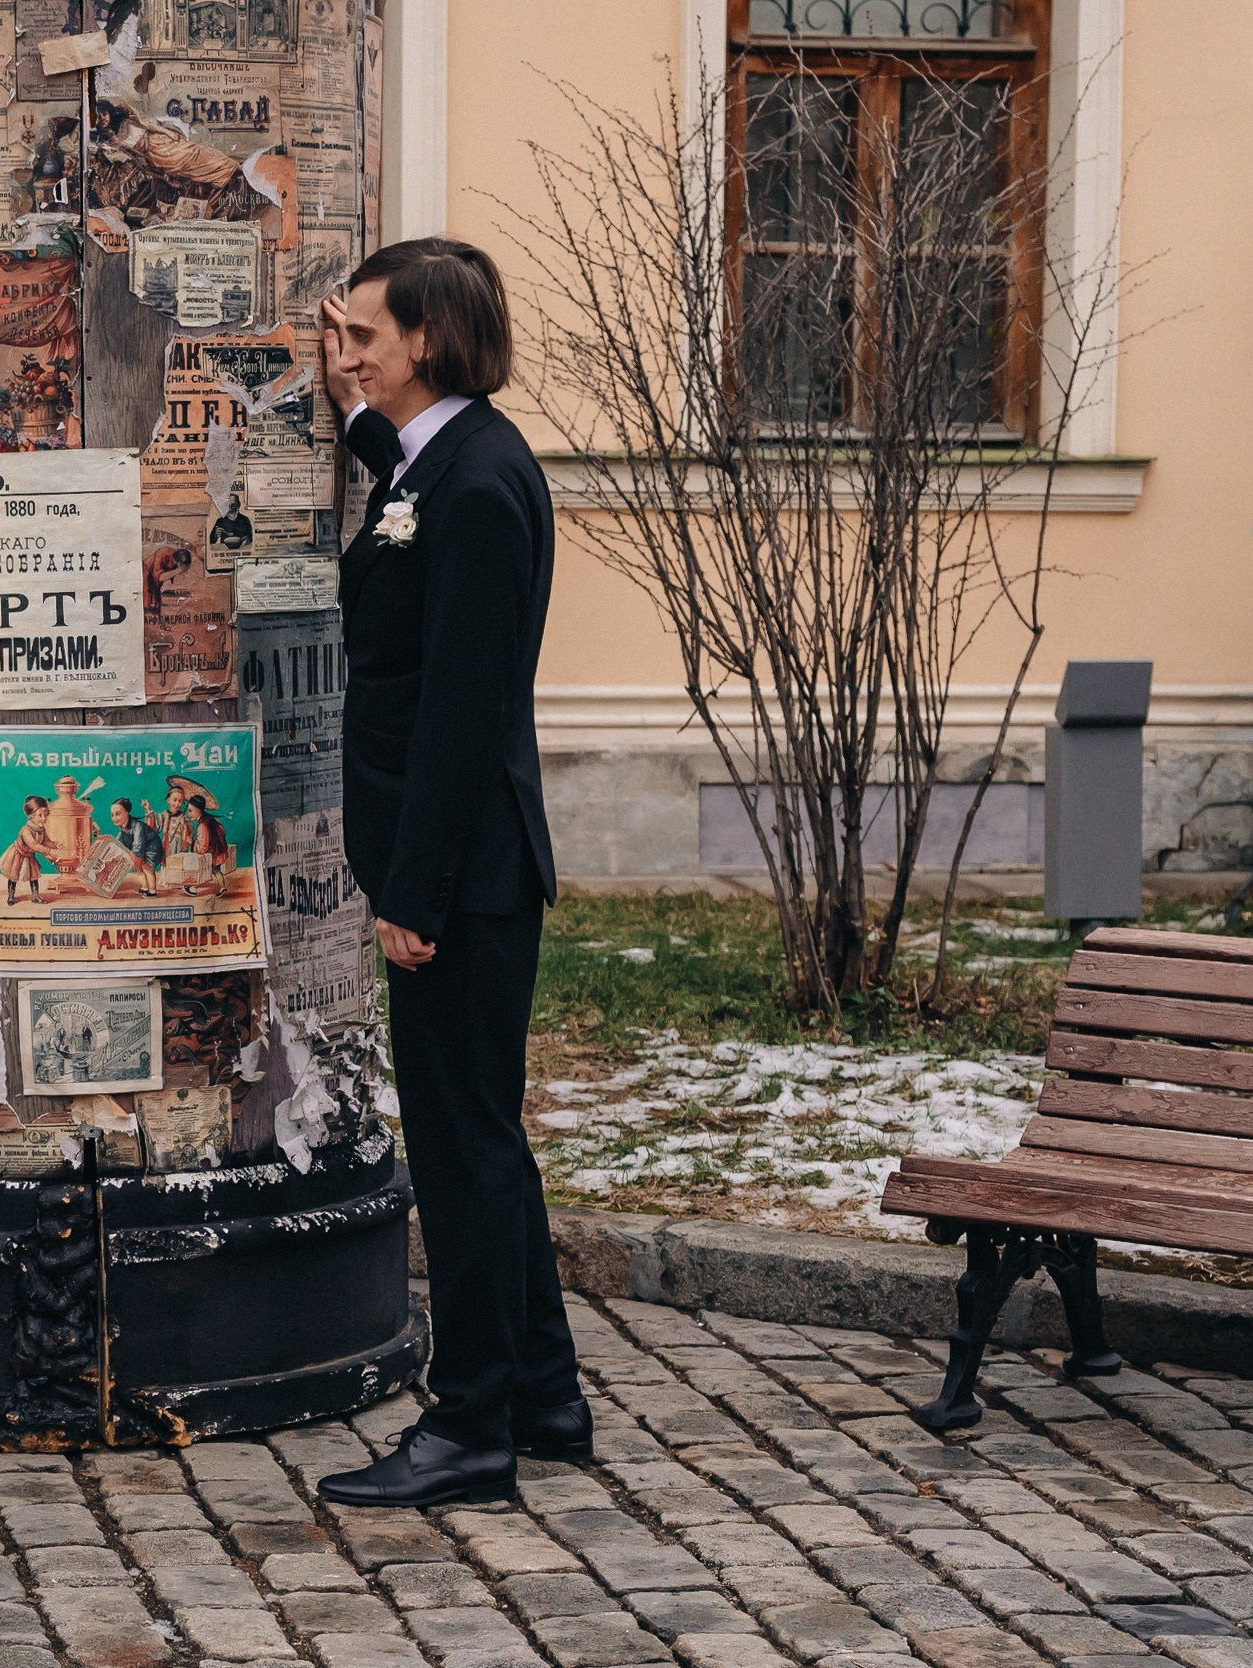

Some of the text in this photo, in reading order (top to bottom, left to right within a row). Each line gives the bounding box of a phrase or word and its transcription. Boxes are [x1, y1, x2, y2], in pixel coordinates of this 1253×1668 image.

[4, 500, 36, 517] 1880
[46, 502, 80, 518] года,
[40, 933, 88, 947] ГУБКИНА
[110, 992, 146, 1002] ПАПИРОСЫ
